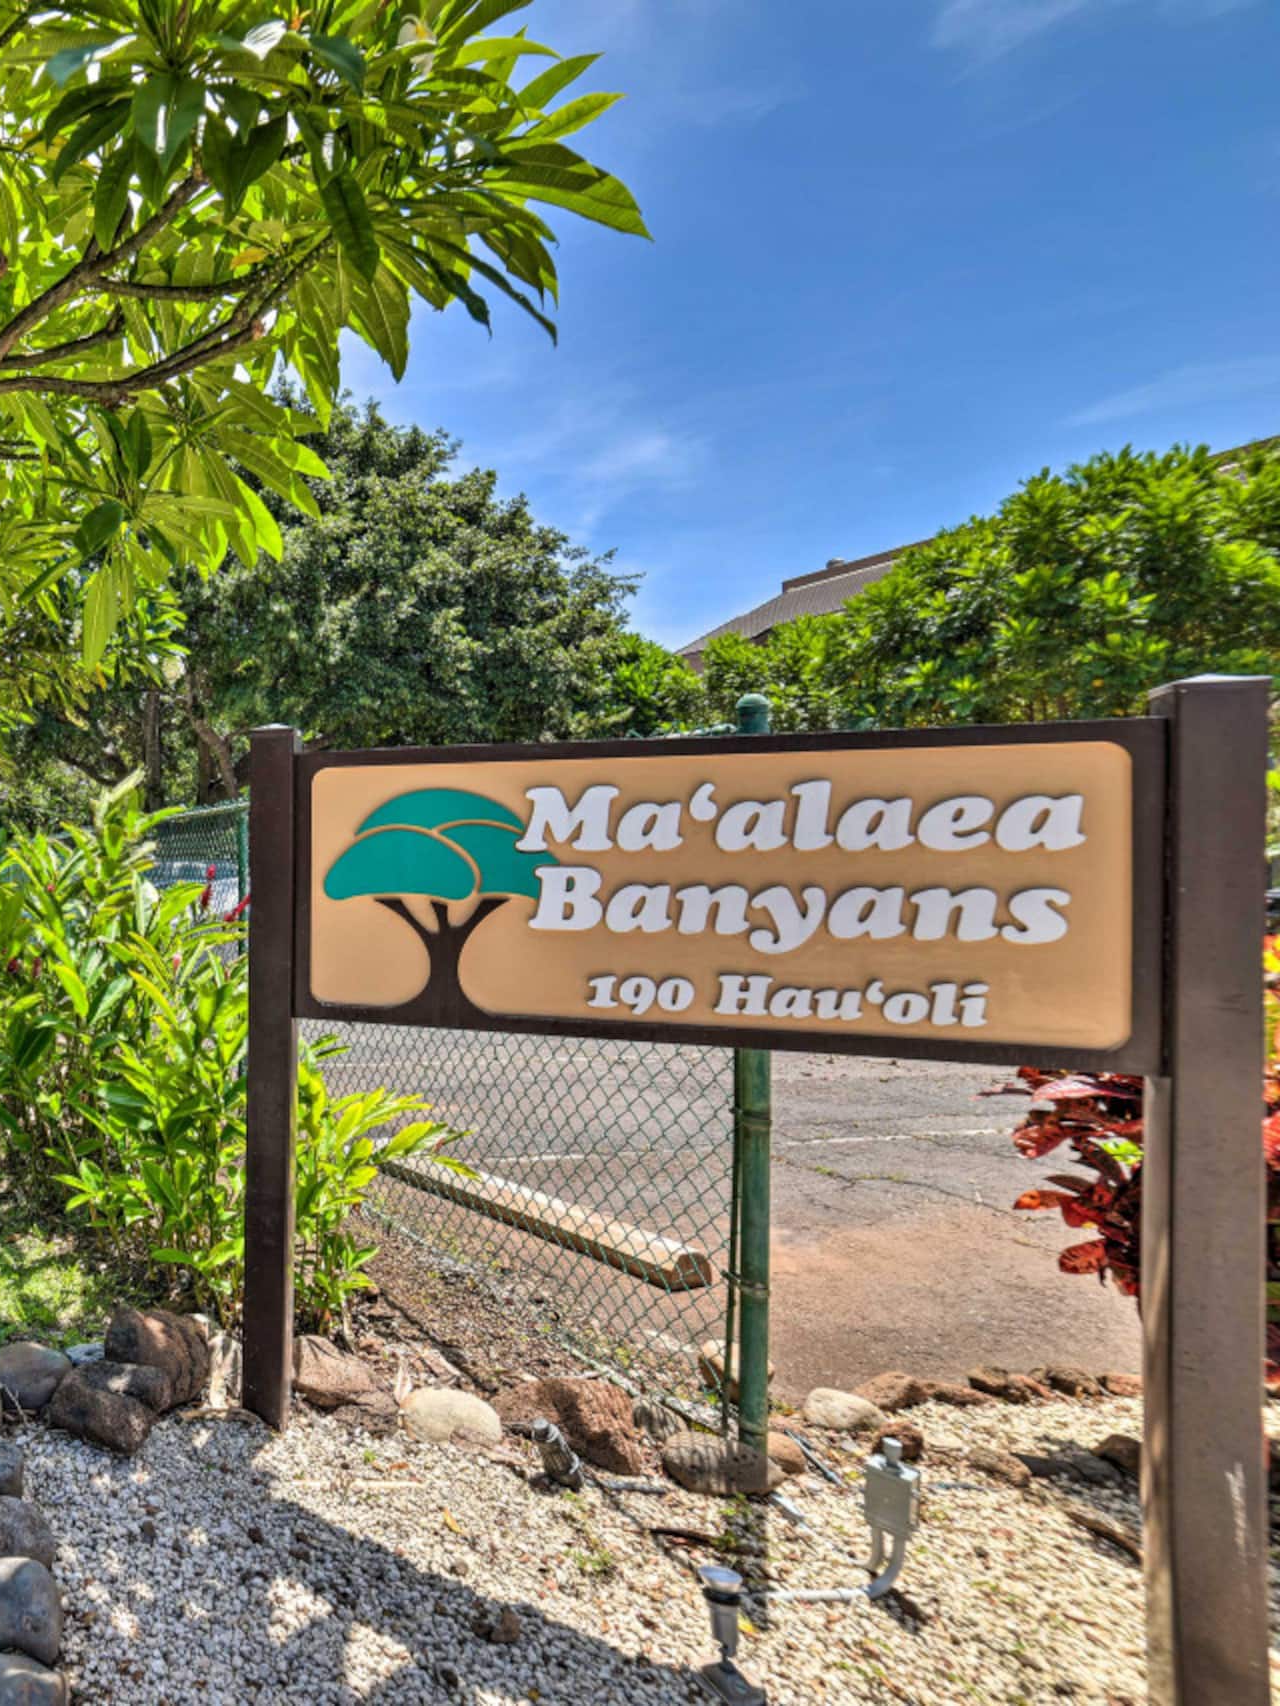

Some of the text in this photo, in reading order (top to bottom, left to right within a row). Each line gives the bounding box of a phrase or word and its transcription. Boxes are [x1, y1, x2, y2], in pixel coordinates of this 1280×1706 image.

[515, 780, 1089, 853] Ma‘alaea
[528, 866, 1074, 956] Banyans
[586, 975, 991, 1029] 190 Hau‘oli
